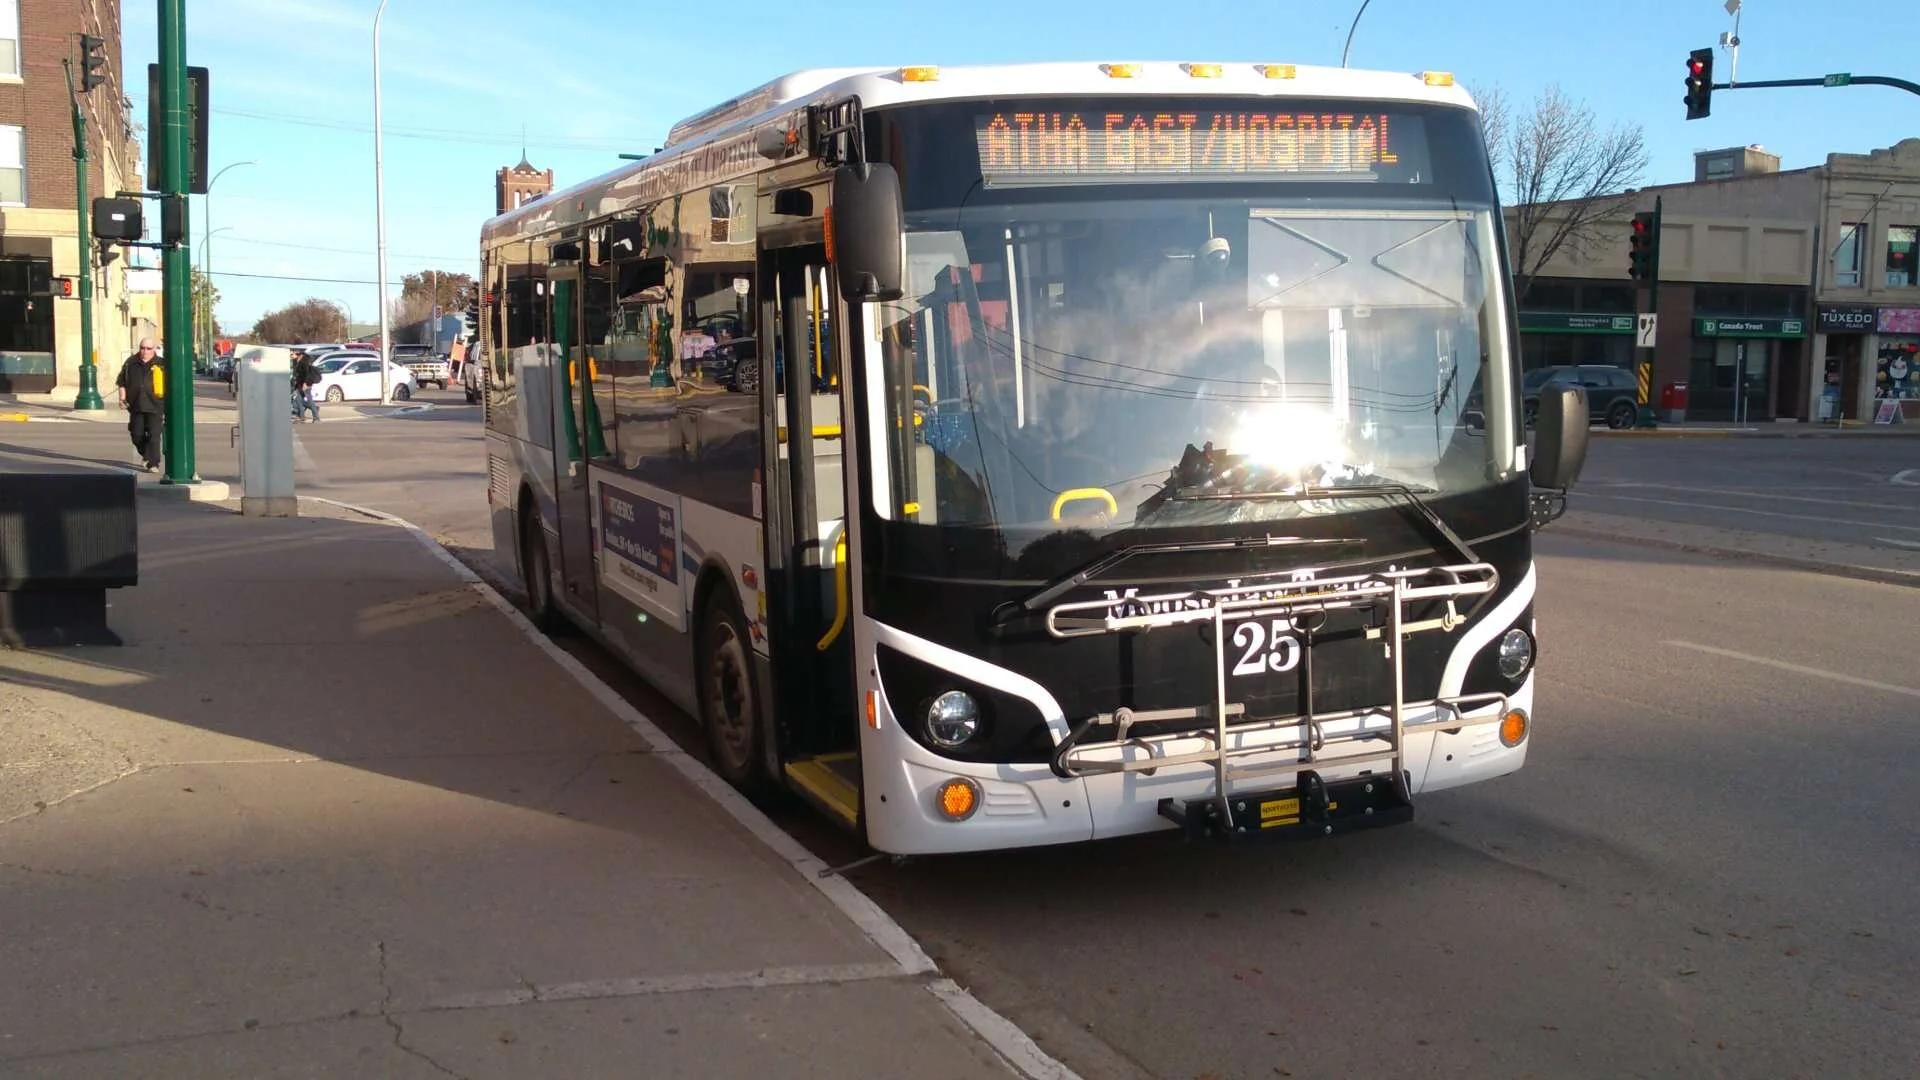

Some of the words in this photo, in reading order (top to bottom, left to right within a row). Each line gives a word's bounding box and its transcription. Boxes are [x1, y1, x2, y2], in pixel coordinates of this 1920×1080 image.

[987, 113, 1088, 166] ATHA
[1719, 322, 1744, 330] Canada
[1744, 322, 1763, 330] Trust
[1232, 617, 1301, 676] 25
